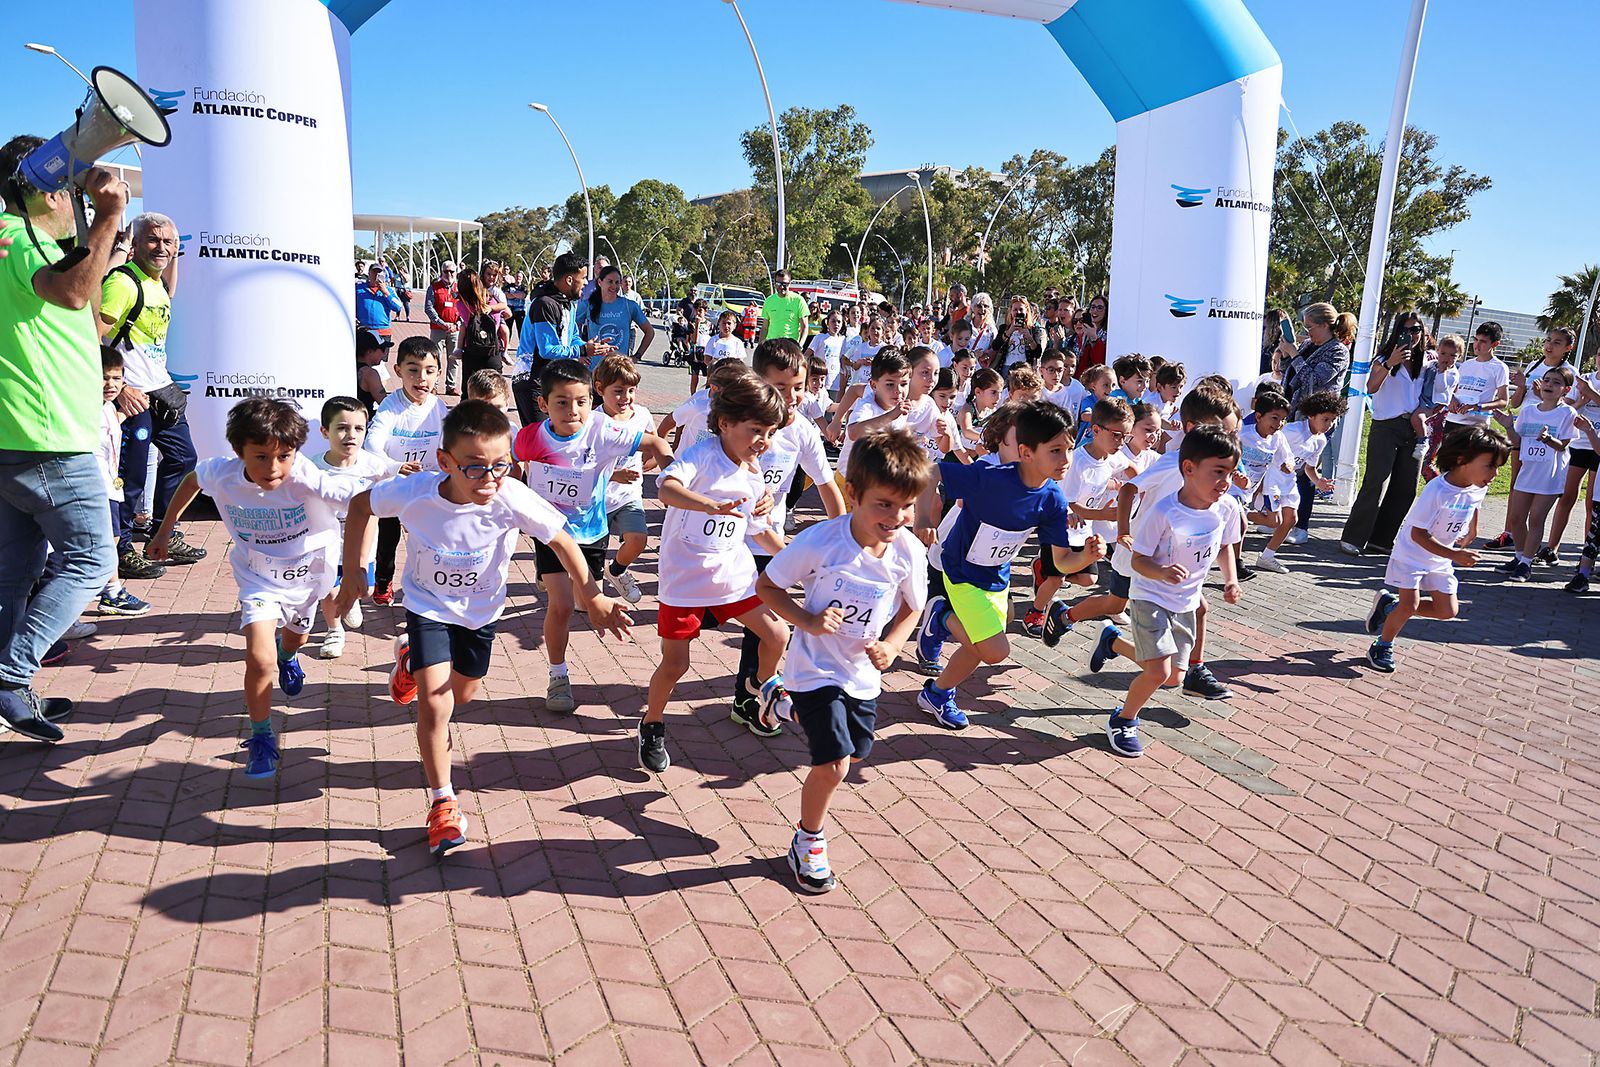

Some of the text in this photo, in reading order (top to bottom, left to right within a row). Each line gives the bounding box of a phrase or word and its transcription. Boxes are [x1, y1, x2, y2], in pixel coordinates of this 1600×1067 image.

[193, 87, 266, 104] Fundación
[192, 102, 317, 128] ATLANTIC COPPER
[200, 232, 271, 246] Fundación
[199, 246, 320, 265] ATLANTIC COPPER
[206, 372, 276, 385] Fundación
[404, 450, 428, 462] 117
[1528, 447, 1546, 457] 079
[547, 480, 579, 498] 176
[703, 518, 736, 538] 019
[434, 570, 478, 588] 033
